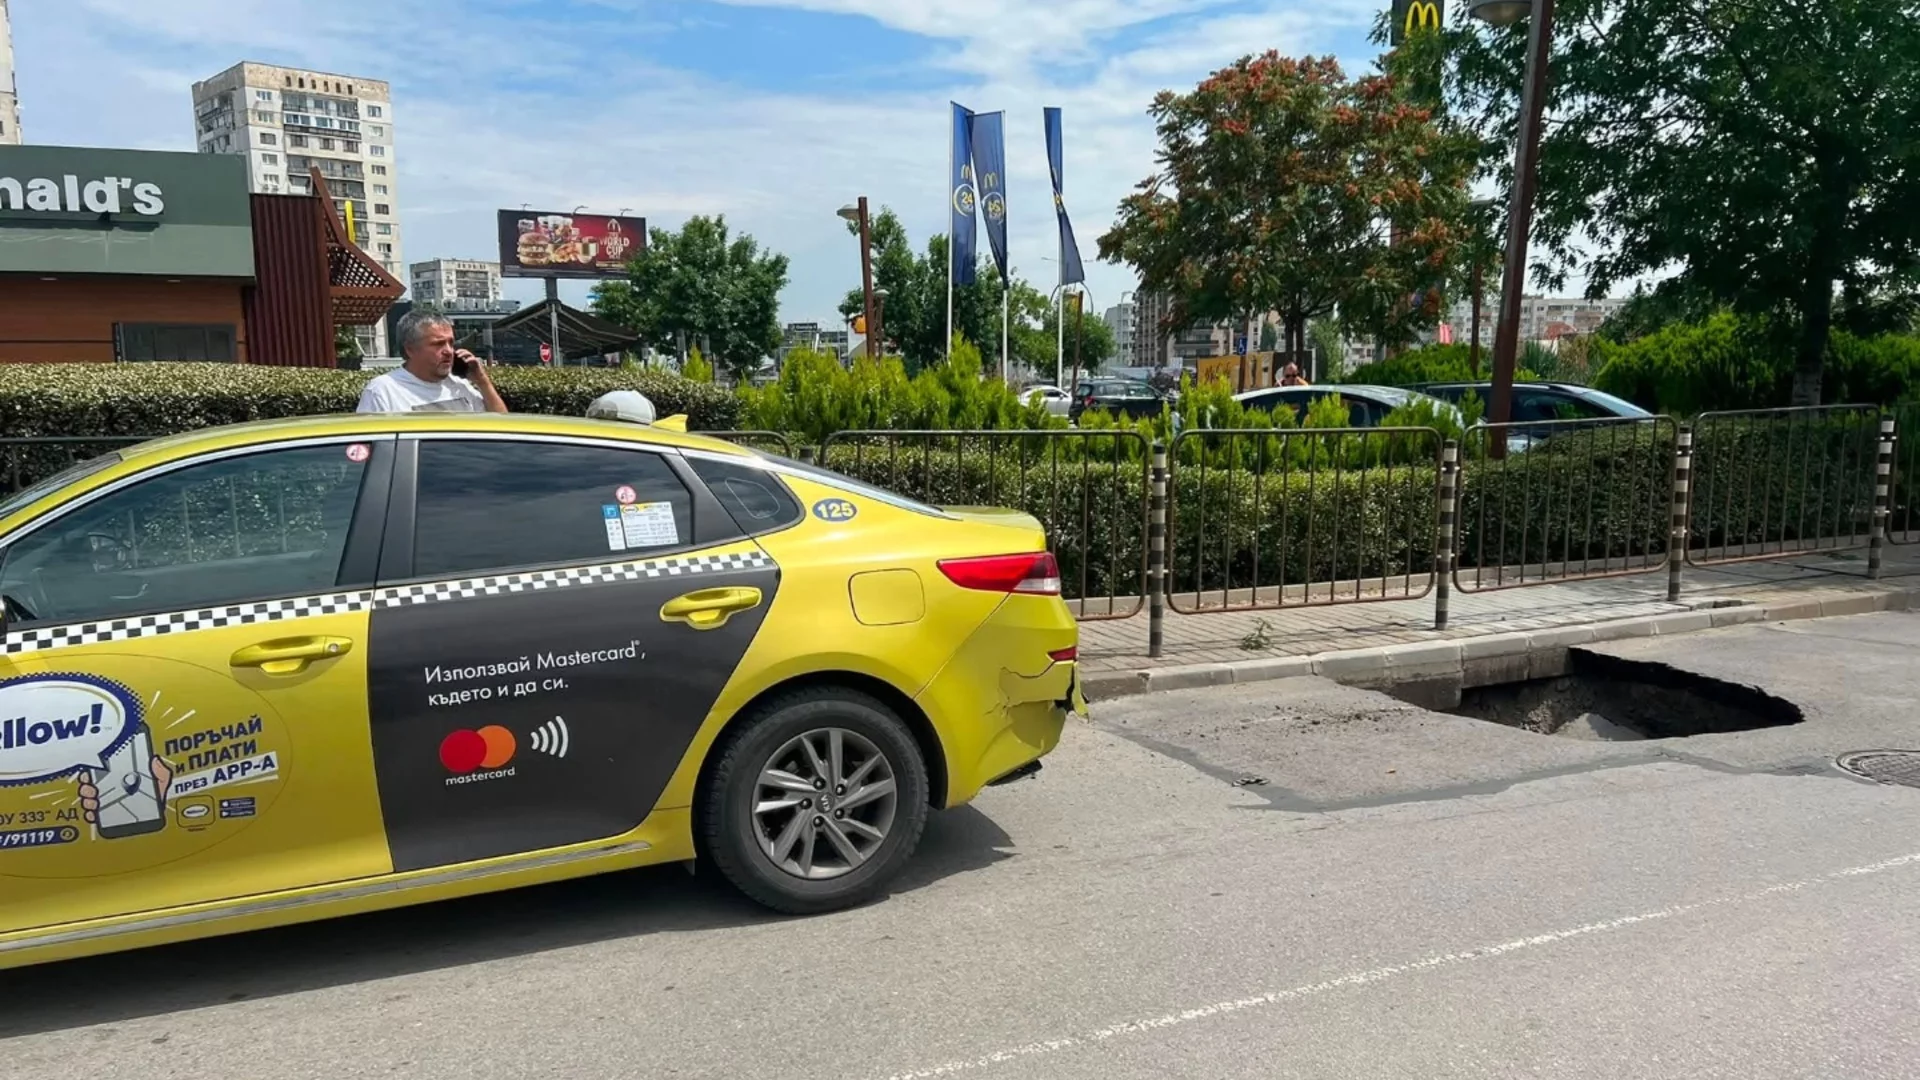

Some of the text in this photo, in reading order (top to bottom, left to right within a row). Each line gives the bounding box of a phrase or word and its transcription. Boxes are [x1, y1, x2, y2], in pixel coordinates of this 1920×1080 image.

[818, 502, 854, 518] 125
[425, 656, 530, 684] Използвай
[428, 678, 569, 706] където и да си.
[0, 703, 103, 749] llow!
[165, 714, 262, 756] ПОРЪЧАЙ
[188, 739, 257, 770] ПЛАТИ
[174, 777, 208, 794] ПРЕЗ
[445, 766, 516, 786] mastercard
[56, 807, 79, 821] АД
[0, 830, 55, 847] /91119
